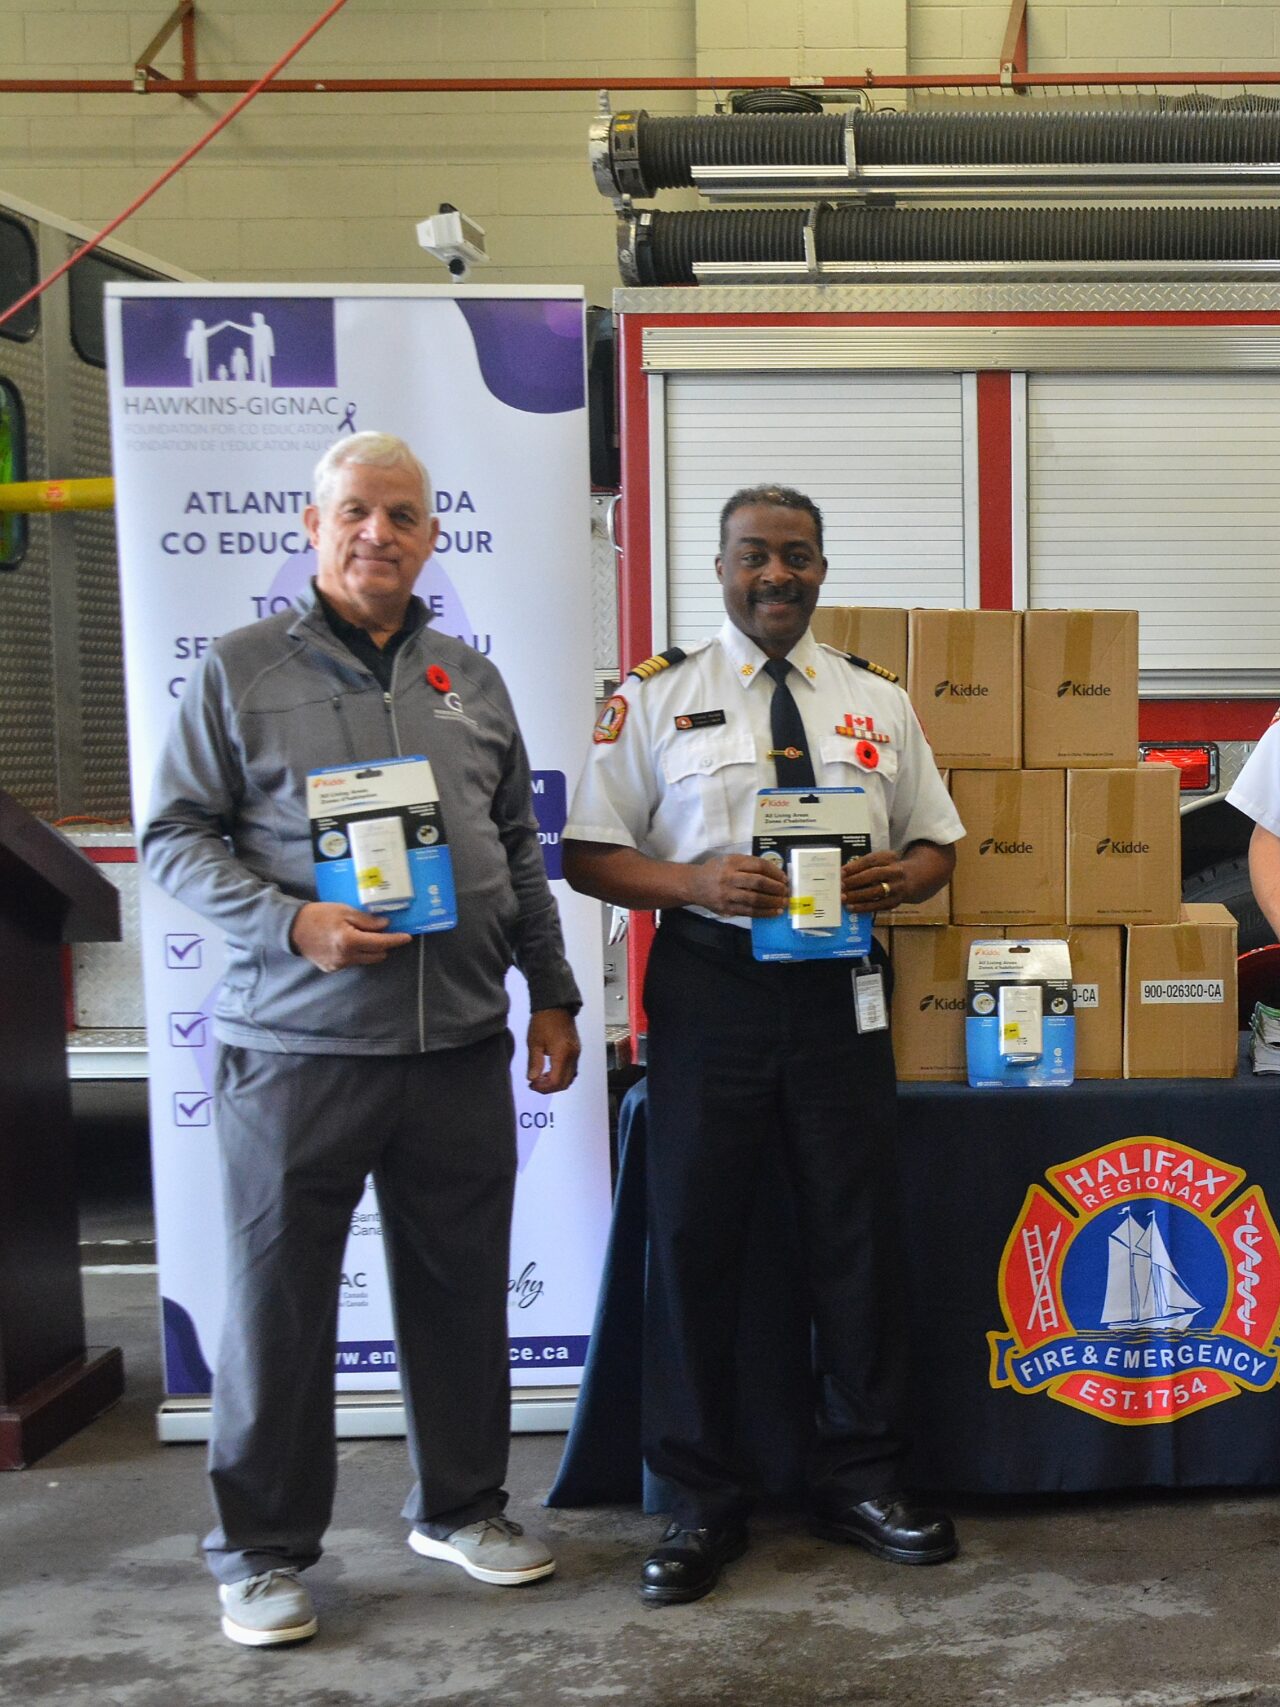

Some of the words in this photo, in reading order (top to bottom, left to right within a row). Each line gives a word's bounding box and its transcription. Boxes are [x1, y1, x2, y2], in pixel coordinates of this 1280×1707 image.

[123, 396, 339, 415] HAWKINS-GIGNAC
[126, 423, 208, 435] FOUNDATION
[211, 423, 236, 435] FOR
[238, 423, 260, 435] CO
[263, 423, 335, 435] EDUCATION
[184, 491, 311, 514] ATLANTI
[161, 532, 206, 555] CO
[434, 531, 493, 553] OUR
[950, 684, 989, 697] Kidde
[1072, 684, 1111, 697] Kidde
[994, 841, 1033, 854] Kidde
[1111, 841, 1149, 854] Kidde
[1144, 984, 1222, 998] 900-0263CO-CA
[935, 998, 965, 1010] Kidd
[520, 1111, 554, 1129] CO!
[1064, 1149, 1227, 1196] HALIFAX
[1083, 1176, 1202, 1208] REGIONAL
[1018, 1345, 1076, 1382] FIRE
[1081, 1345, 1099, 1364] &
[1104, 1344, 1267, 1377] EMERGENCY
